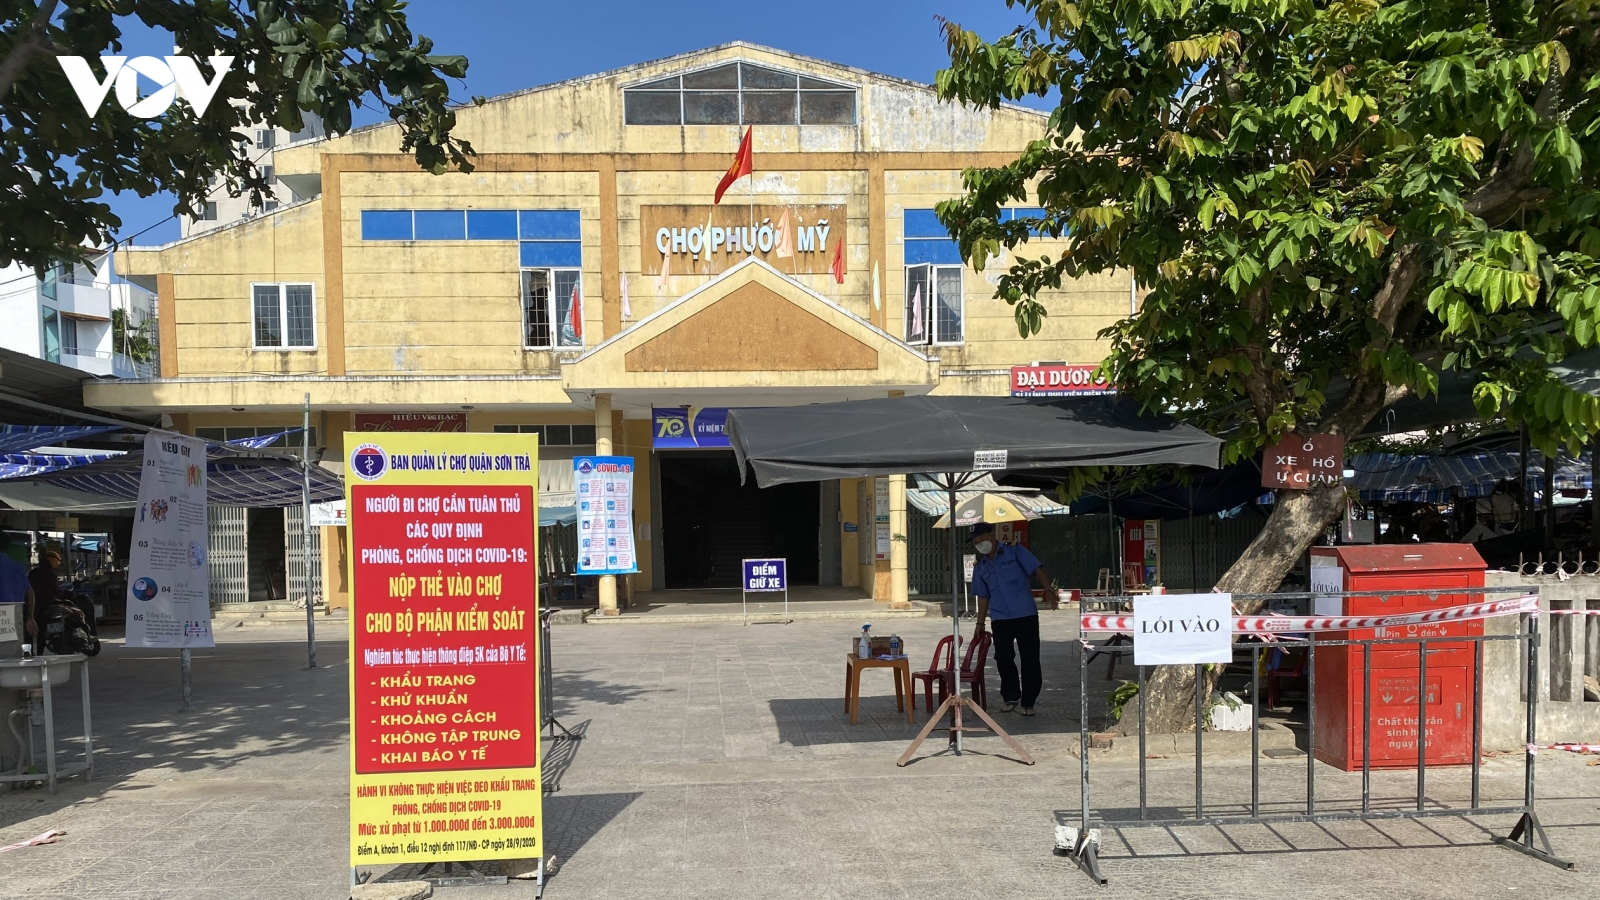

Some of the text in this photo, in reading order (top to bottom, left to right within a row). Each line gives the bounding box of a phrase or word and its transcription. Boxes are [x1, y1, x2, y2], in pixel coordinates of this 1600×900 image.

[656, 224, 704, 260] CHỢ
[797, 219, 830, 253] MỸ
[1017, 371, 1045, 389] ĐẠI
[656, 419, 684, 437] 70
[391, 450, 531, 473] BAN QUẢN LÝ CHỢ QUẬN SƠN TRÀ
[596, 463, 630, 473] COVID-19
[1276, 456, 1297, 465] XE
[366, 493, 520, 516] NGƯỜI ĐI CHỢ CẦN TUÂN THỦ
[406, 520, 482, 541] CÁC QUY ĐỊNH
[362, 543, 527, 566] PHÒNG, CHỐNG DỊCH COVID-19:
[752, 562, 777, 575] ĐIỂM
[389, 570, 502, 601] NỘP THẺ VÀO CHỢ
[750, 576, 780, 588] GIỮ XE
[366, 603, 525, 637] CHO BỘ PHẬN KIỂM SOÁT
[1142, 615, 1220, 634] LỐI VÀO
[1421, 628, 1437, 637] đèn
[365, 642, 526, 667] Nghiêm túc thực hiện thông điệp 5K của Bộ Y Tế:
[380, 671, 476, 688] KHẨU TRANG
[380, 689, 468, 706] KHỬ KHUẨN
[380, 709, 496, 725] KHOẢNG CÁCH
[1378, 717, 1401, 725] Chất
[1404, 717, 1419, 725] thả
[381, 729, 520, 745] KHÔNG TẬP TRUNG
[1387, 728, 1433, 737] sinh hạt
[381, 745, 488, 763] KHAI BÁO Y TẾ
[1389, 741, 1413, 749] nguy
[357, 776, 535, 798] HÀNH VI KHÔNG THỰC HIỆN VIỆC ĐEO KHẨU TRANG
[392, 798, 501, 816] PHÒNG, CHỐNG DỊCH COVID-19
[358, 816, 534, 836] Mức xử phạt từ 1.000.000đ đến 3.000.000đ
[358, 837, 535, 856] Điểm A, khoản 1, điều 12 nghị định 117/NĐ CP ngày 28/9/2020
